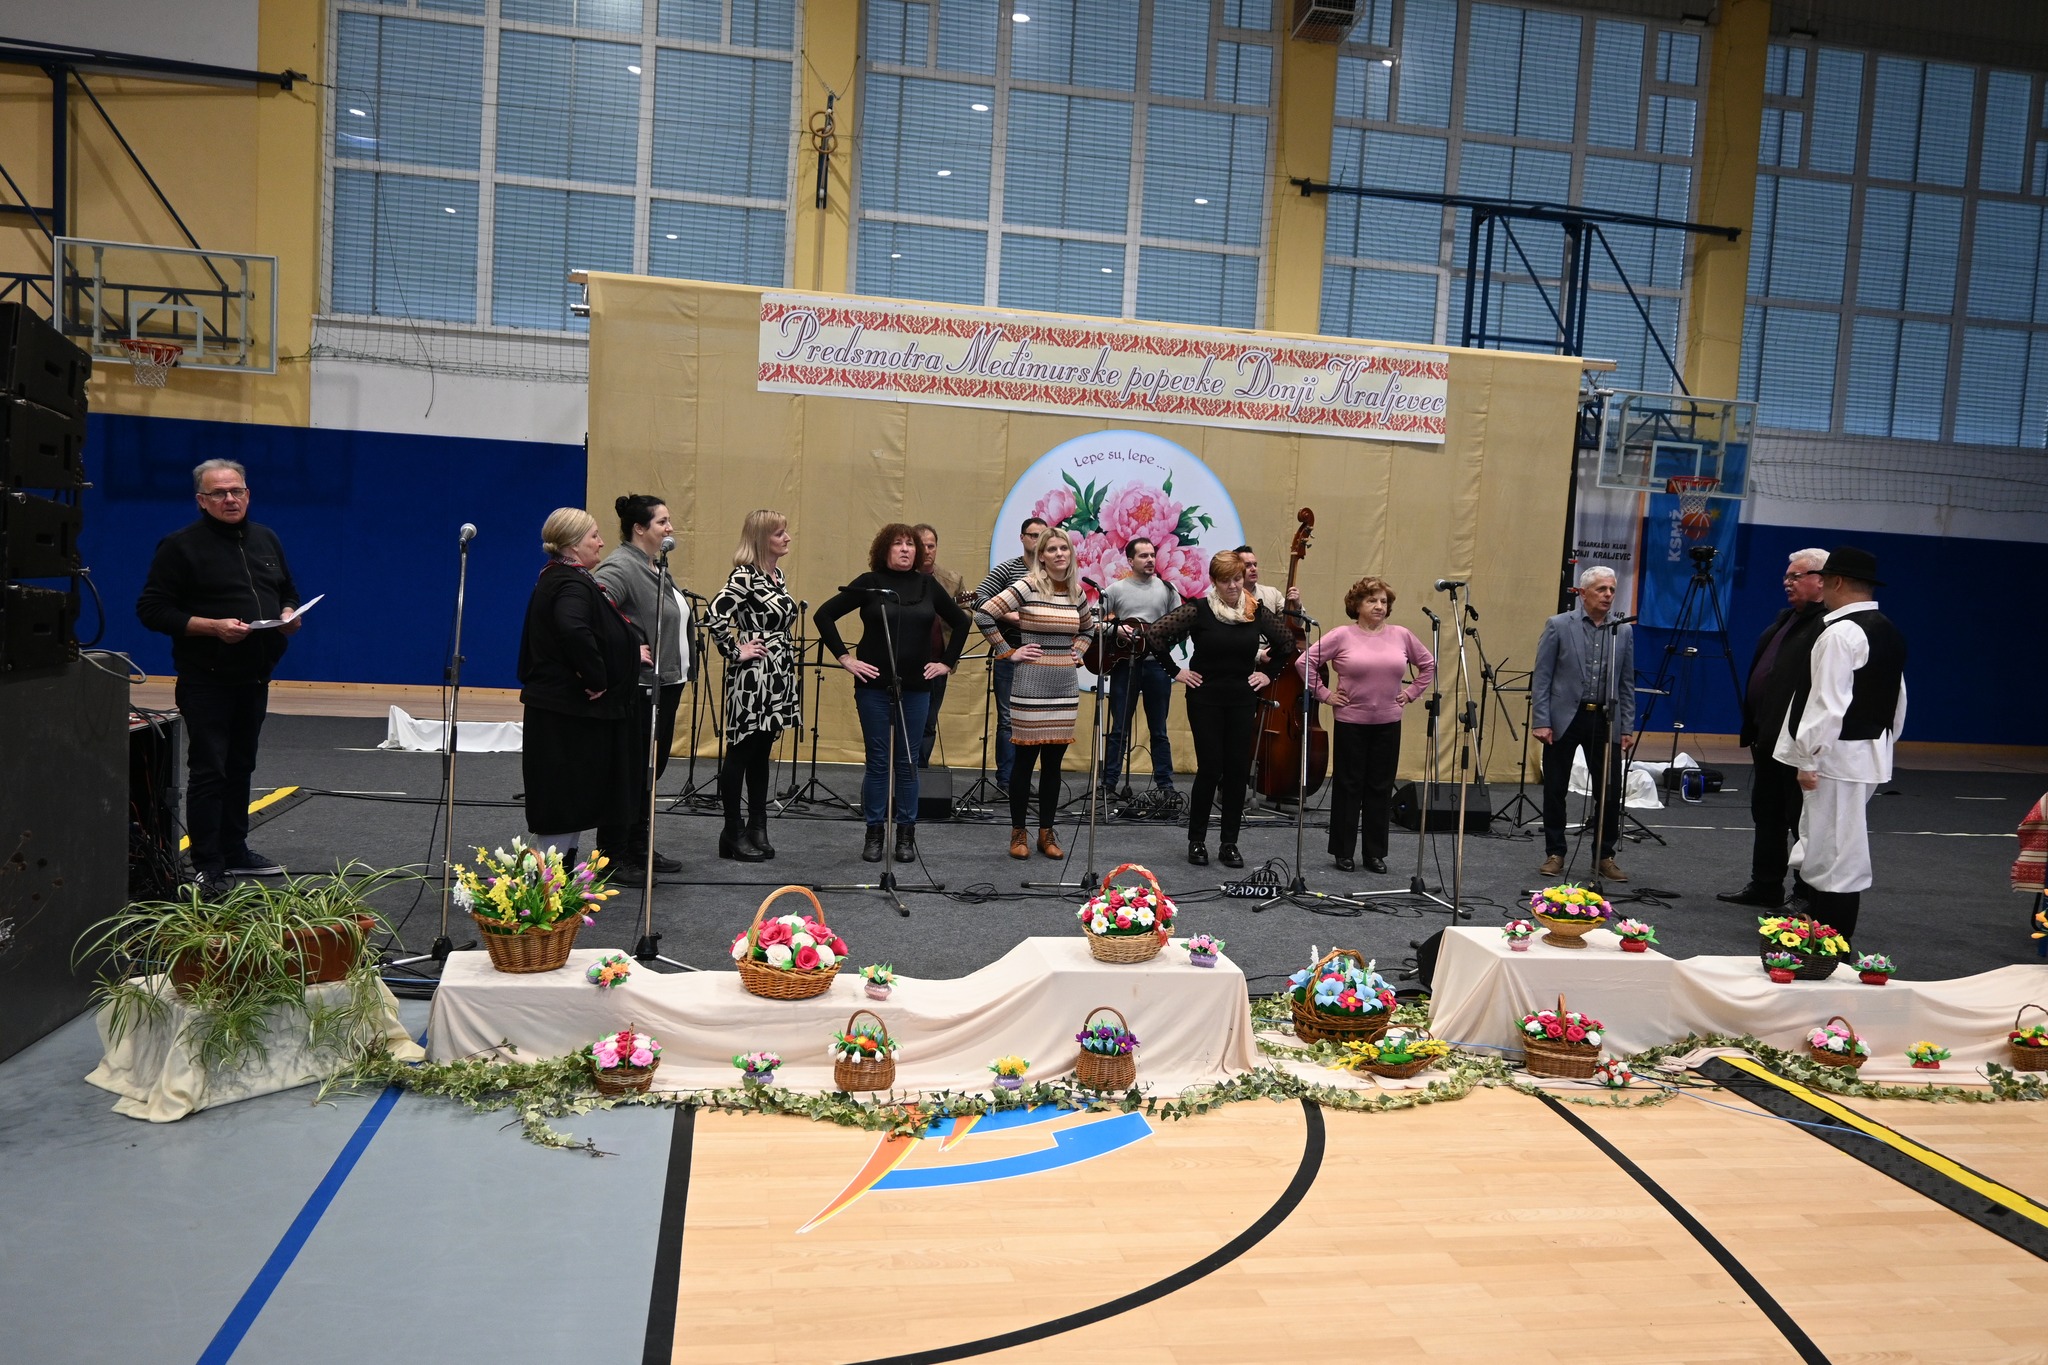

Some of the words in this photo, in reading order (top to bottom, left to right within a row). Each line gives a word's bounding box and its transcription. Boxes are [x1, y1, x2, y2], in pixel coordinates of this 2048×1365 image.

[775, 311, 942, 371] Predsmotra
[947, 326, 1121, 385] Međimurske
[1121, 354, 1225, 403] popevke
[1234, 350, 1315, 416] Donji
[1320, 357, 1446, 423] Kraljevec
[1074, 452, 1104, 467] Lepe
[1108, 450, 1125, 462] su,
[1592, 551, 1631, 560] KRALJEVEC
[1227, 885, 1269, 896] RADIO
